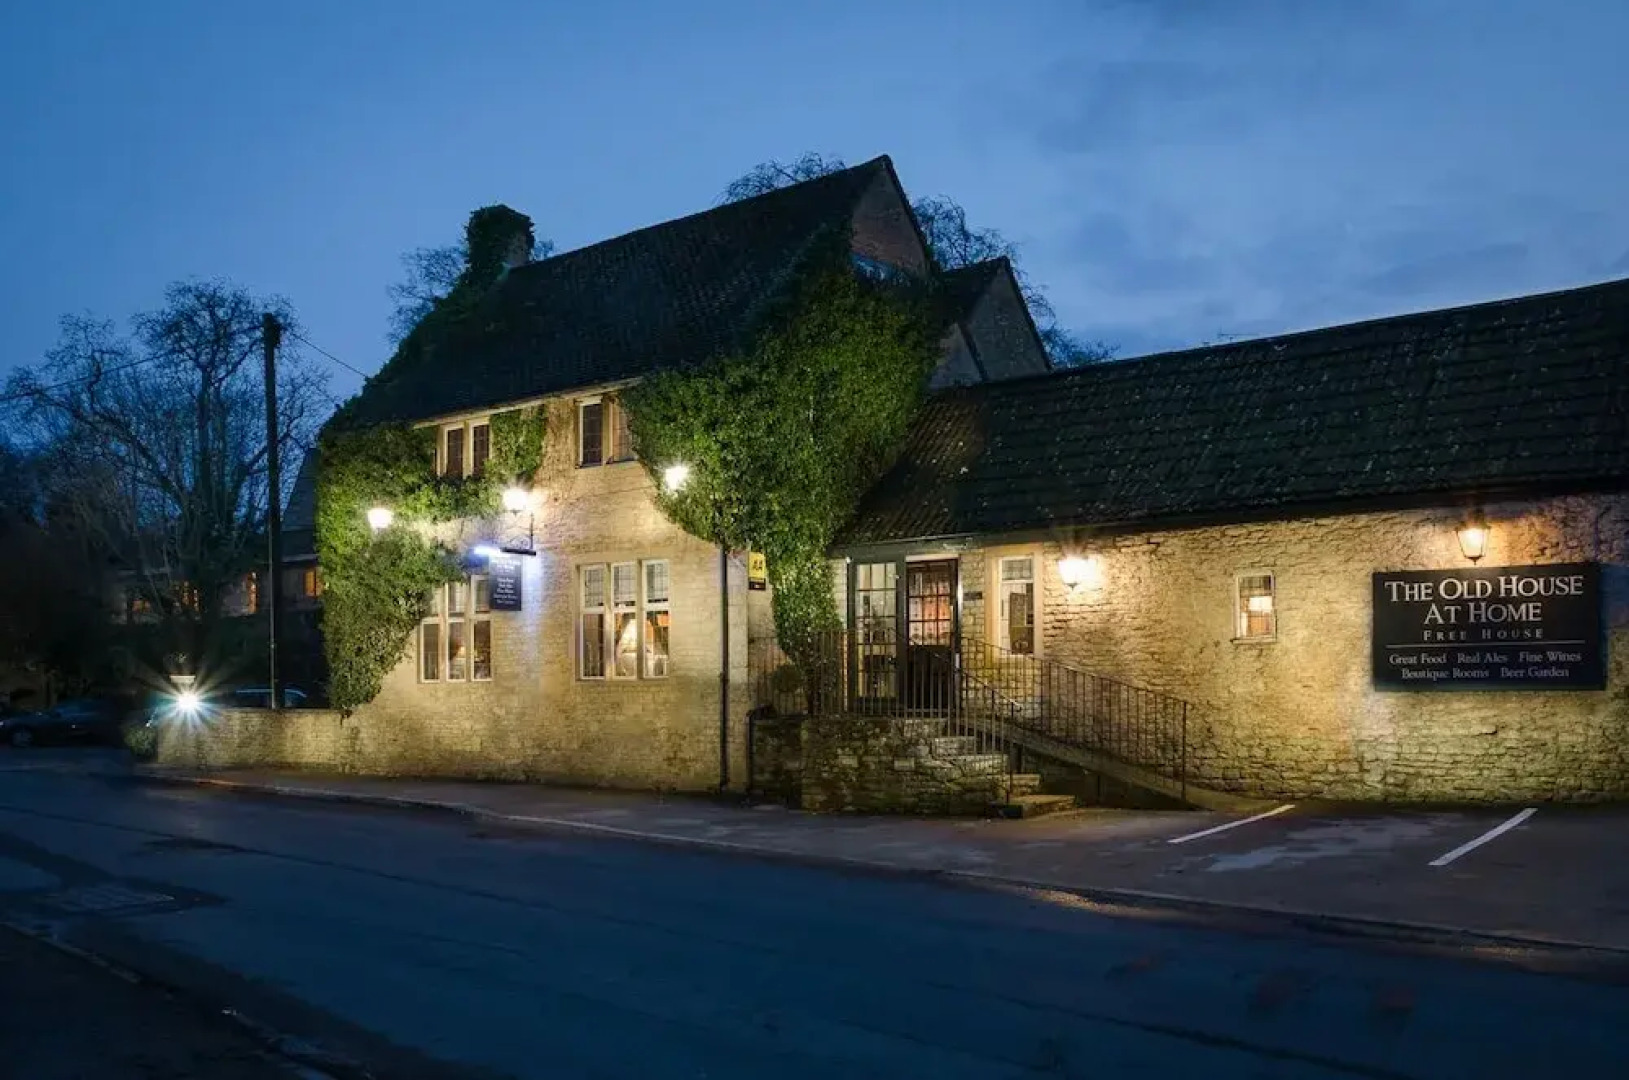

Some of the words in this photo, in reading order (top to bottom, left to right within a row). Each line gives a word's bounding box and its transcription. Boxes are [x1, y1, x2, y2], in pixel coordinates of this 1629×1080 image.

[1384, 580, 1434, 602] THE
[1438, 577, 1493, 600] OLD
[1498, 575, 1584, 597] HOUSE
[1423, 602, 1462, 625] AT
[1469, 602, 1542, 623] HOME
[1423, 630, 1467, 641] FREE
[1481, 628, 1544, 640] HOUSE
[1389, 653, 1417, 664] Great
[1421, 652, 1447, 664] Food
[1457, 652, 1480, 663] Real
[1484, 652, 1508, 663] Ales
[1519, 651, 1543, 662] Fine
[1546, 651, 1582, 662] Wines
[1401, 669, 1449, 681] Boutique
[1452, 668, 1490, 679] Rooms
[1500, 667, 1525, 678] Beer
[1528, 667, 1570, 678] Garden
